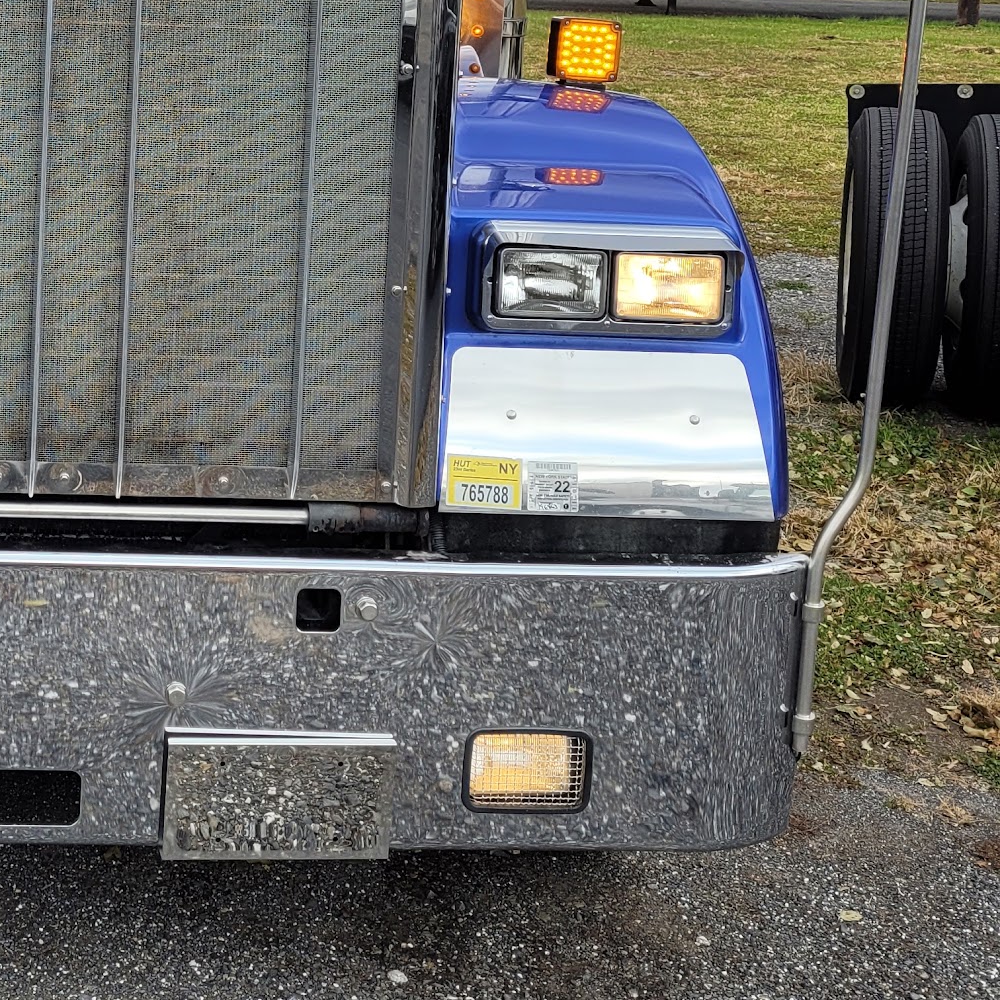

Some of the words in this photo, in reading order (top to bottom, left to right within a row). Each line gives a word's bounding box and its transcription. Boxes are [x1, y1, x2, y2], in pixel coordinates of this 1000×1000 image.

[499, 463, 518, 474] NY
[554, 480, 570, 493] 22
[461, 483, 509, 504] 765788
